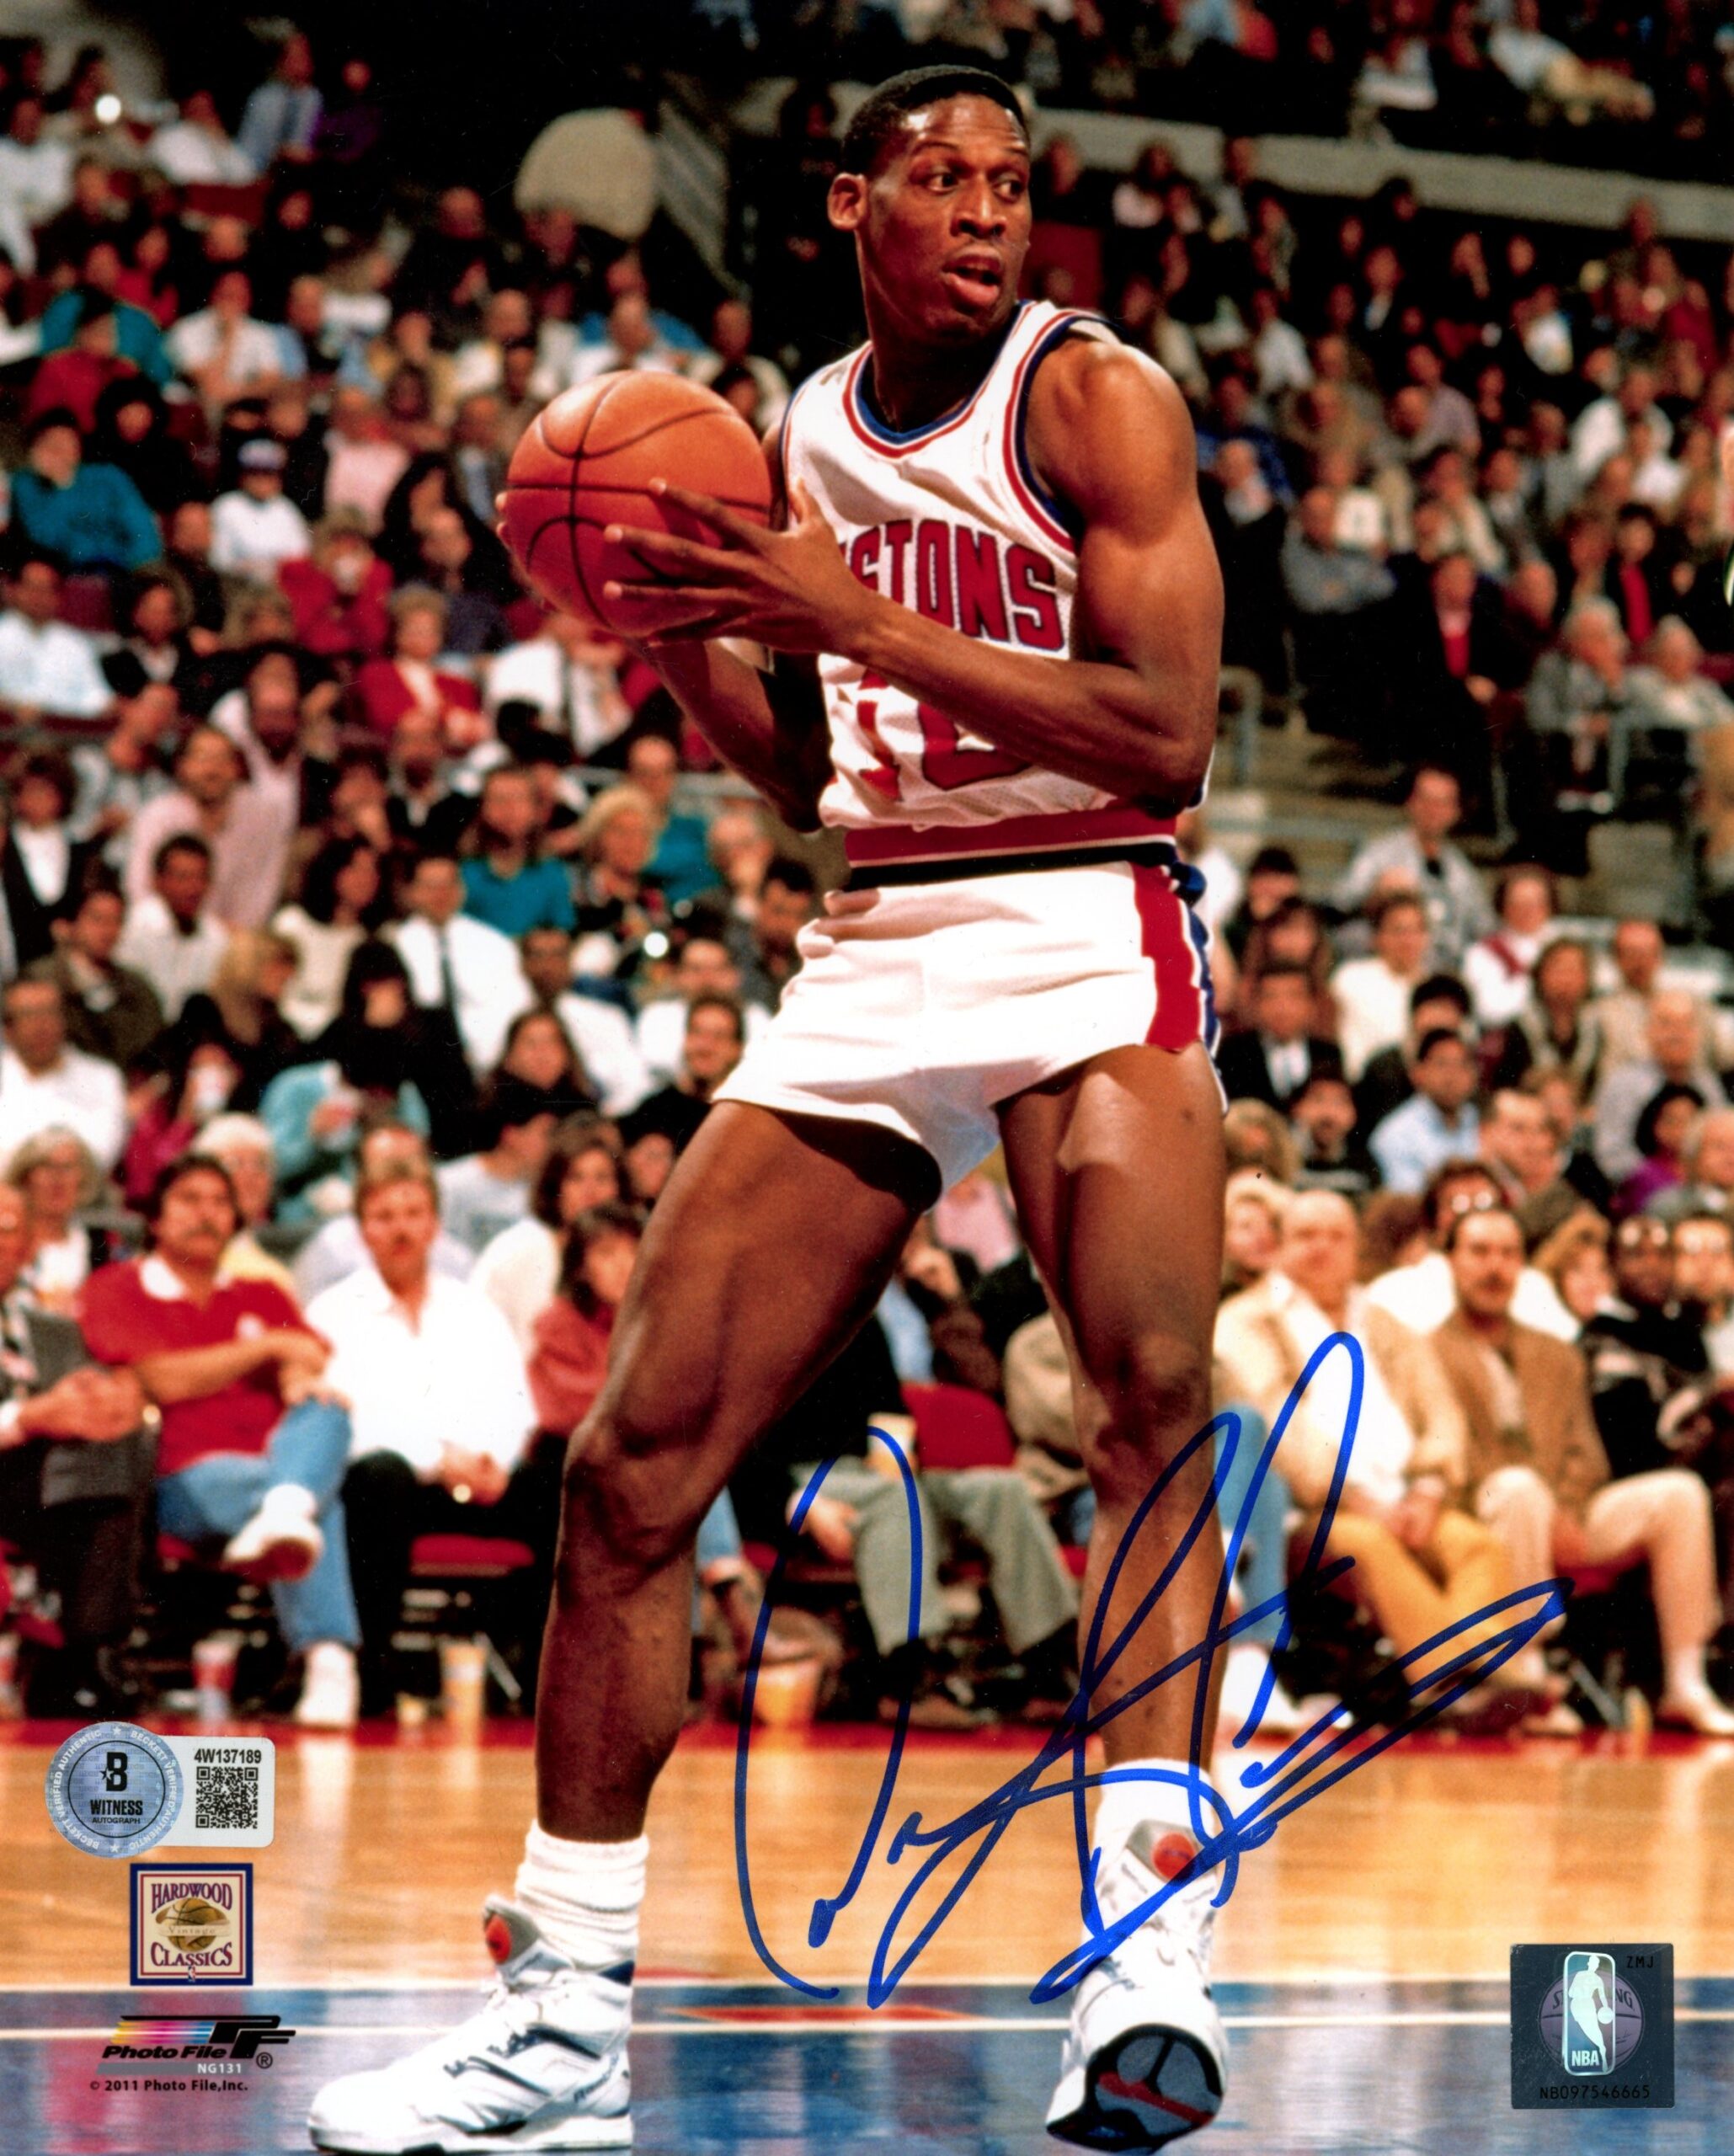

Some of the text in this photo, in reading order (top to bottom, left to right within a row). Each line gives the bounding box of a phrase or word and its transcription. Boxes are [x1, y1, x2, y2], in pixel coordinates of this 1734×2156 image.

[838, 518, 1064, 652] STONS
[194, 1748, 263, 1764] 4W137189
[106, 1752, 128, 1791] B
[53, 1730, 102, 1850] BECKETT VERIFIED AUTHENTIC
[129, 1731, 177, 1850] BECKETT VERIFIED AUTHENTIC
[90, 1800, 143, 1816] WITNESS
[1626, 1956, 1654, 1969] ZMJ
[1571, 2050, 1600, 2067] NBA
